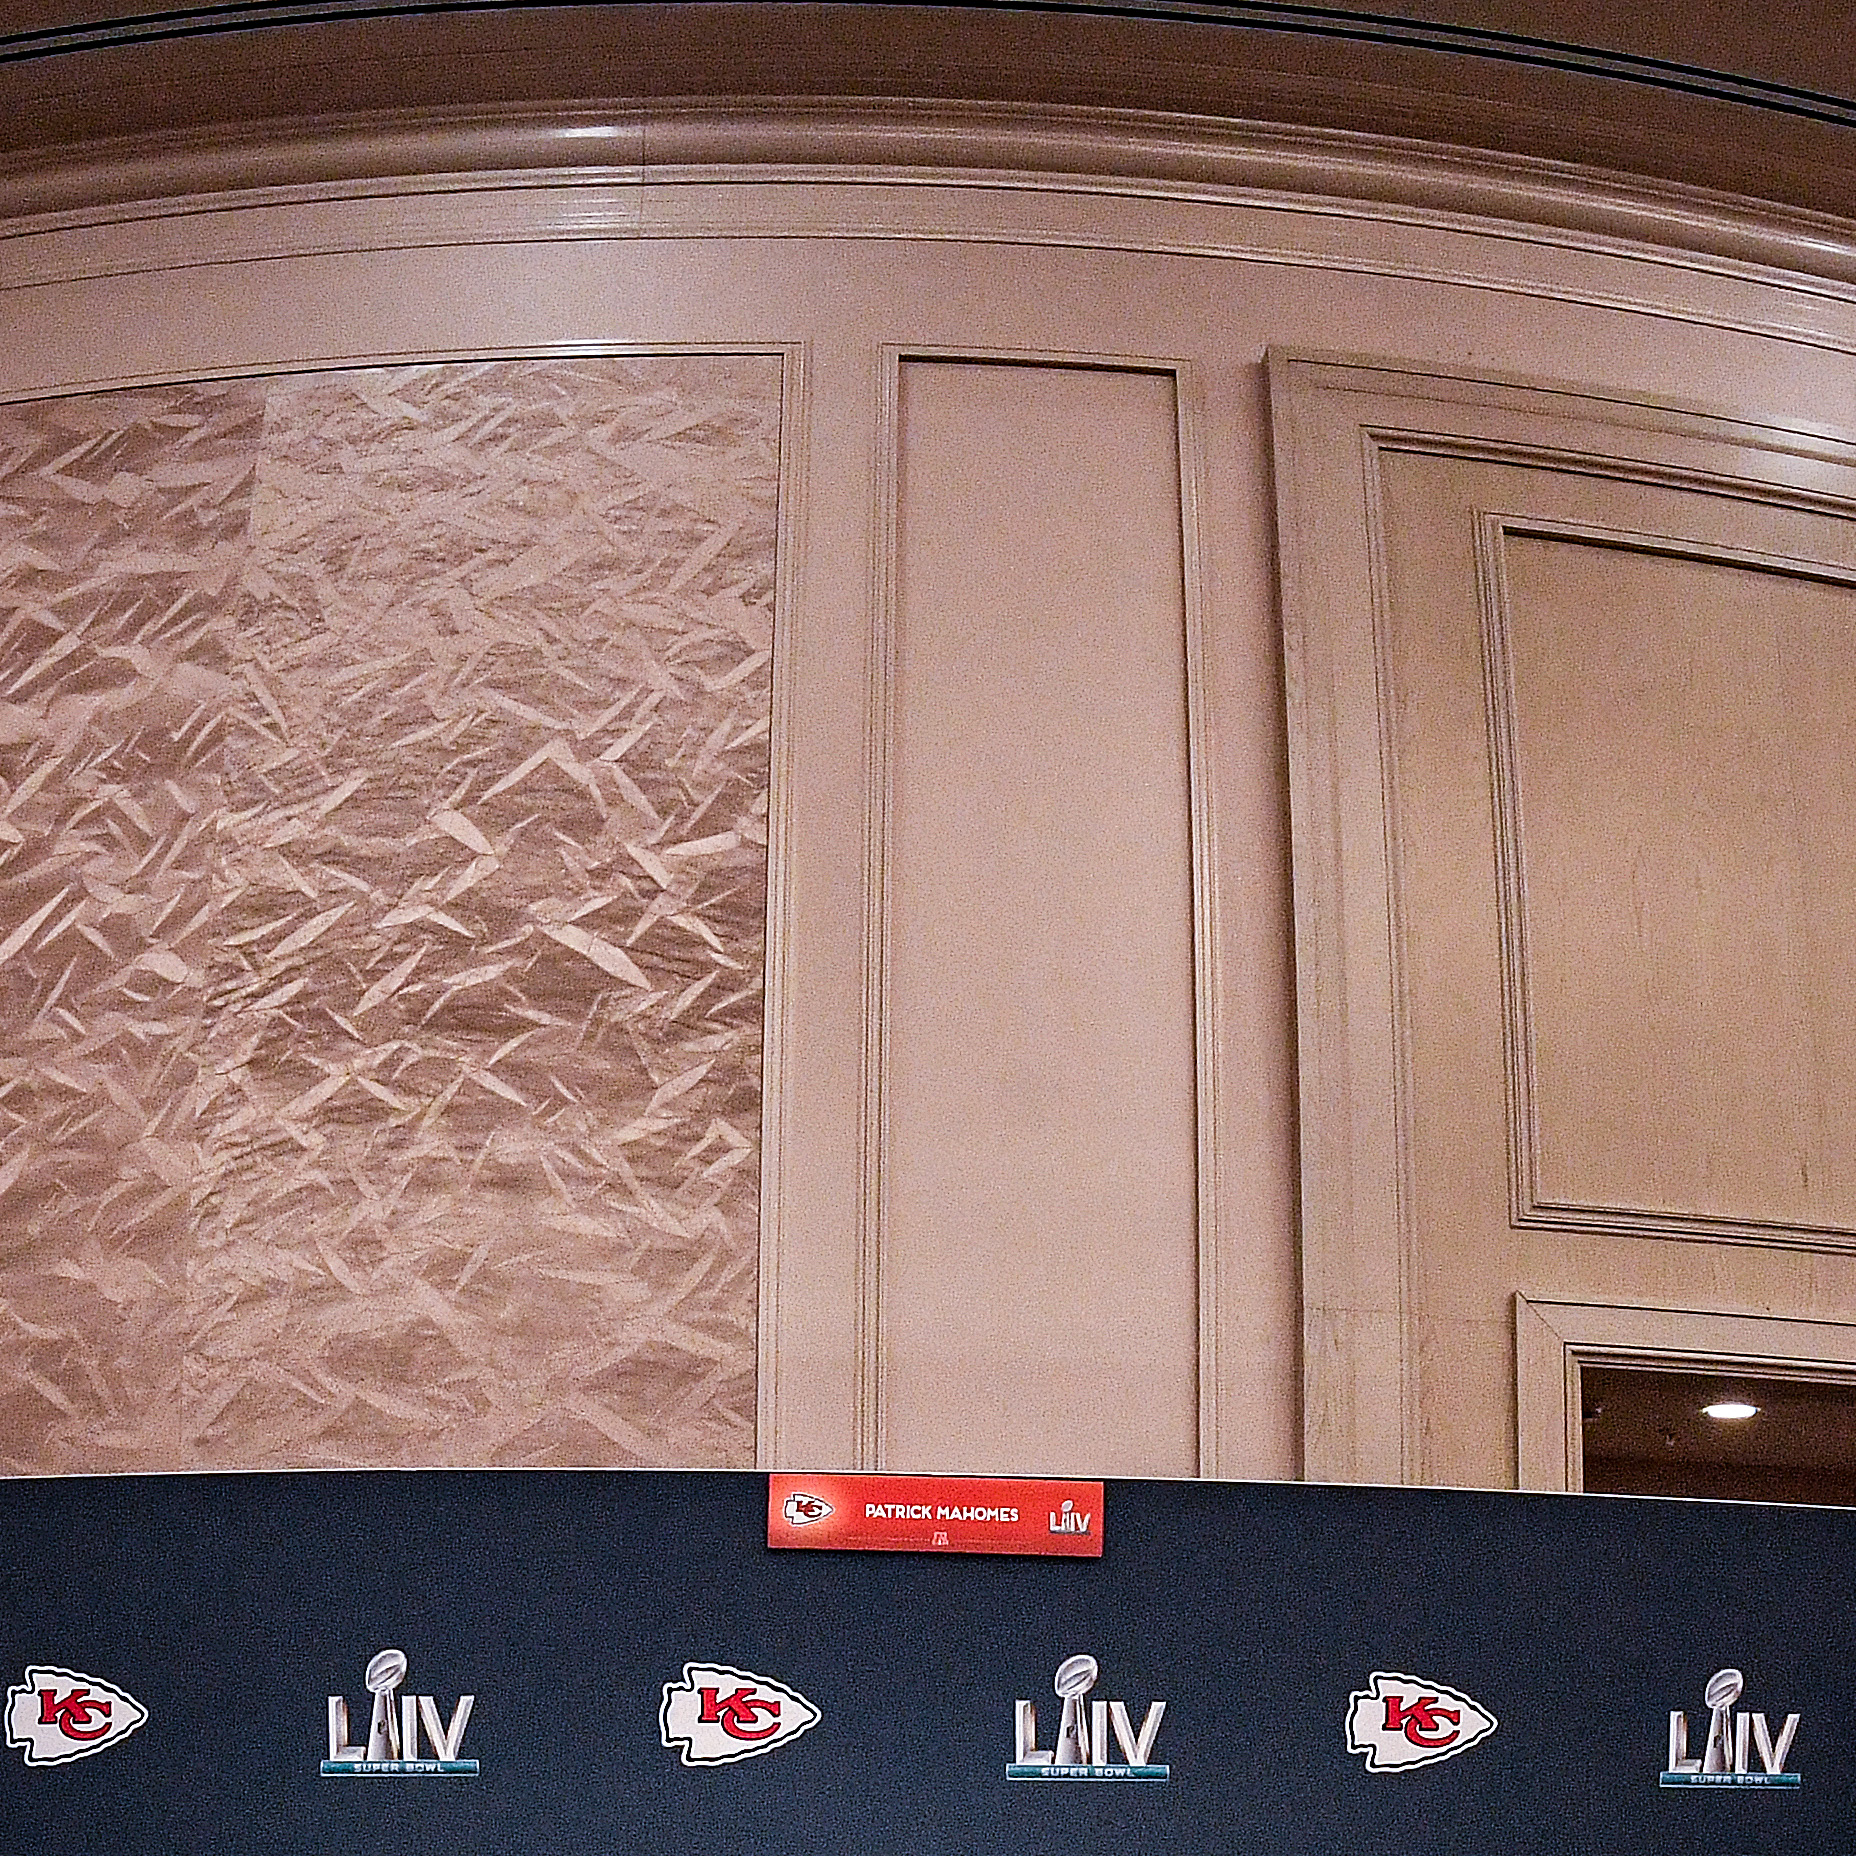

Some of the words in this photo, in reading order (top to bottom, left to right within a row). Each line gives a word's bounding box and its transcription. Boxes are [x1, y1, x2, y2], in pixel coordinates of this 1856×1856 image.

[865, 1503, 932, 1520] PATRICK
[937, 1506, 1019, 1522] MAHOMES
[1049, 1511, 1091, 1532] LIV
[39, 1688, 112, 1740] KC
[328, 1695, 475, 1761] LIV
[698, 1687, 781, 1740] KC
[1015, 1700, 1166, 1765] LIV
[1382, 1696, 1460, 1747] KC
[1669, 1711, 1800, 1773] LIV
